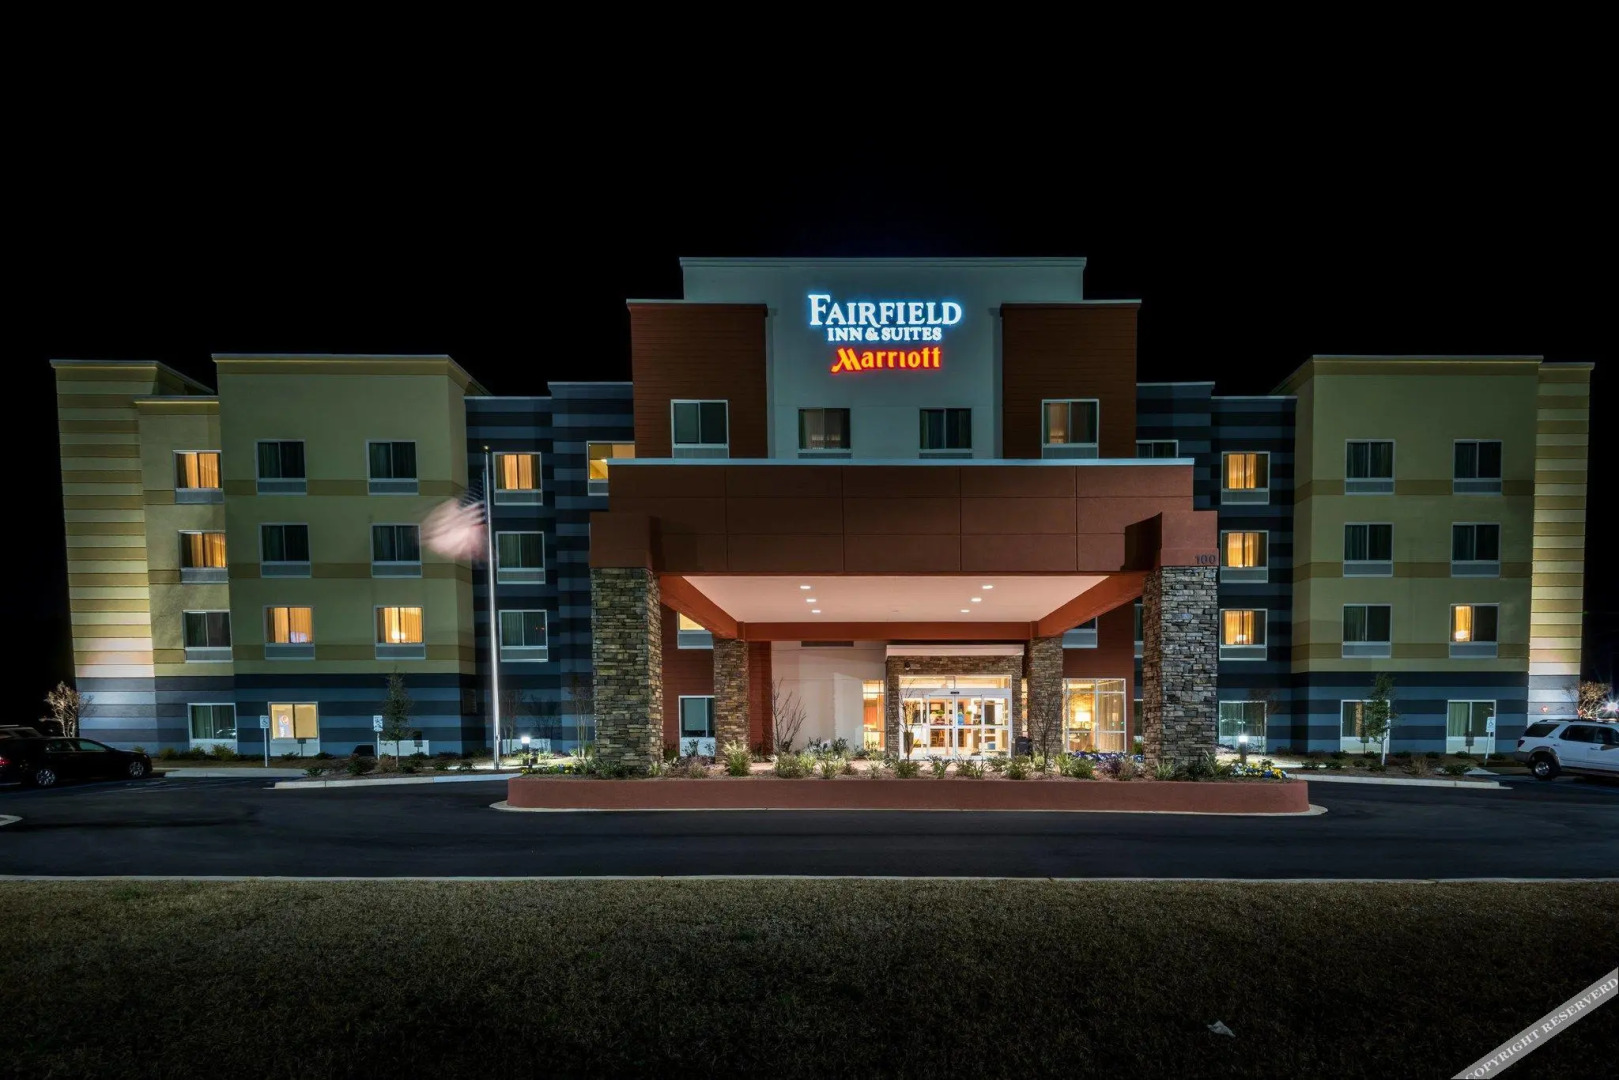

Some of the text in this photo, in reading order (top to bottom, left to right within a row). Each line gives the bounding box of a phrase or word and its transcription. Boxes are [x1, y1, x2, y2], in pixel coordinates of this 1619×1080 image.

[808, 294, 962, 328] FAIRFIELD
[827, 327, 863, 341] INN
[881, 327, 942, 341] SUITES
[831, 346, 941, 373] Marriott
[1195, 554, 1216, 565] 100
